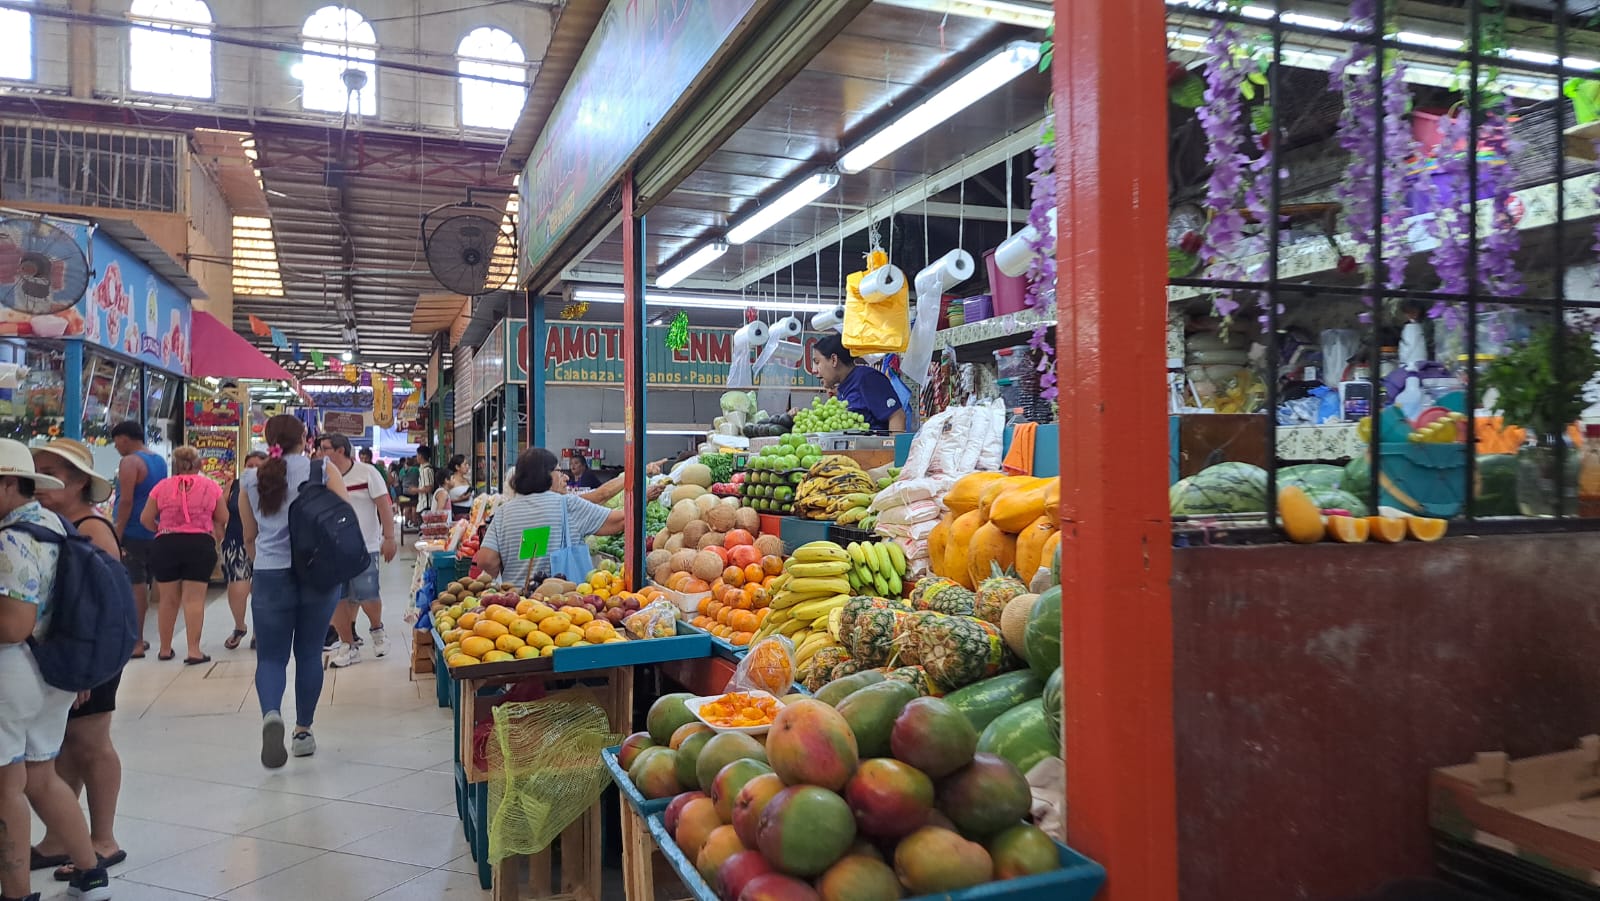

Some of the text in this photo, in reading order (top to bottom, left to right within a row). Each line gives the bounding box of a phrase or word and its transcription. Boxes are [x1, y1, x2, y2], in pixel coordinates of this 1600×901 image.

[555, 367, 729, 384] Calabaza anos Papay
